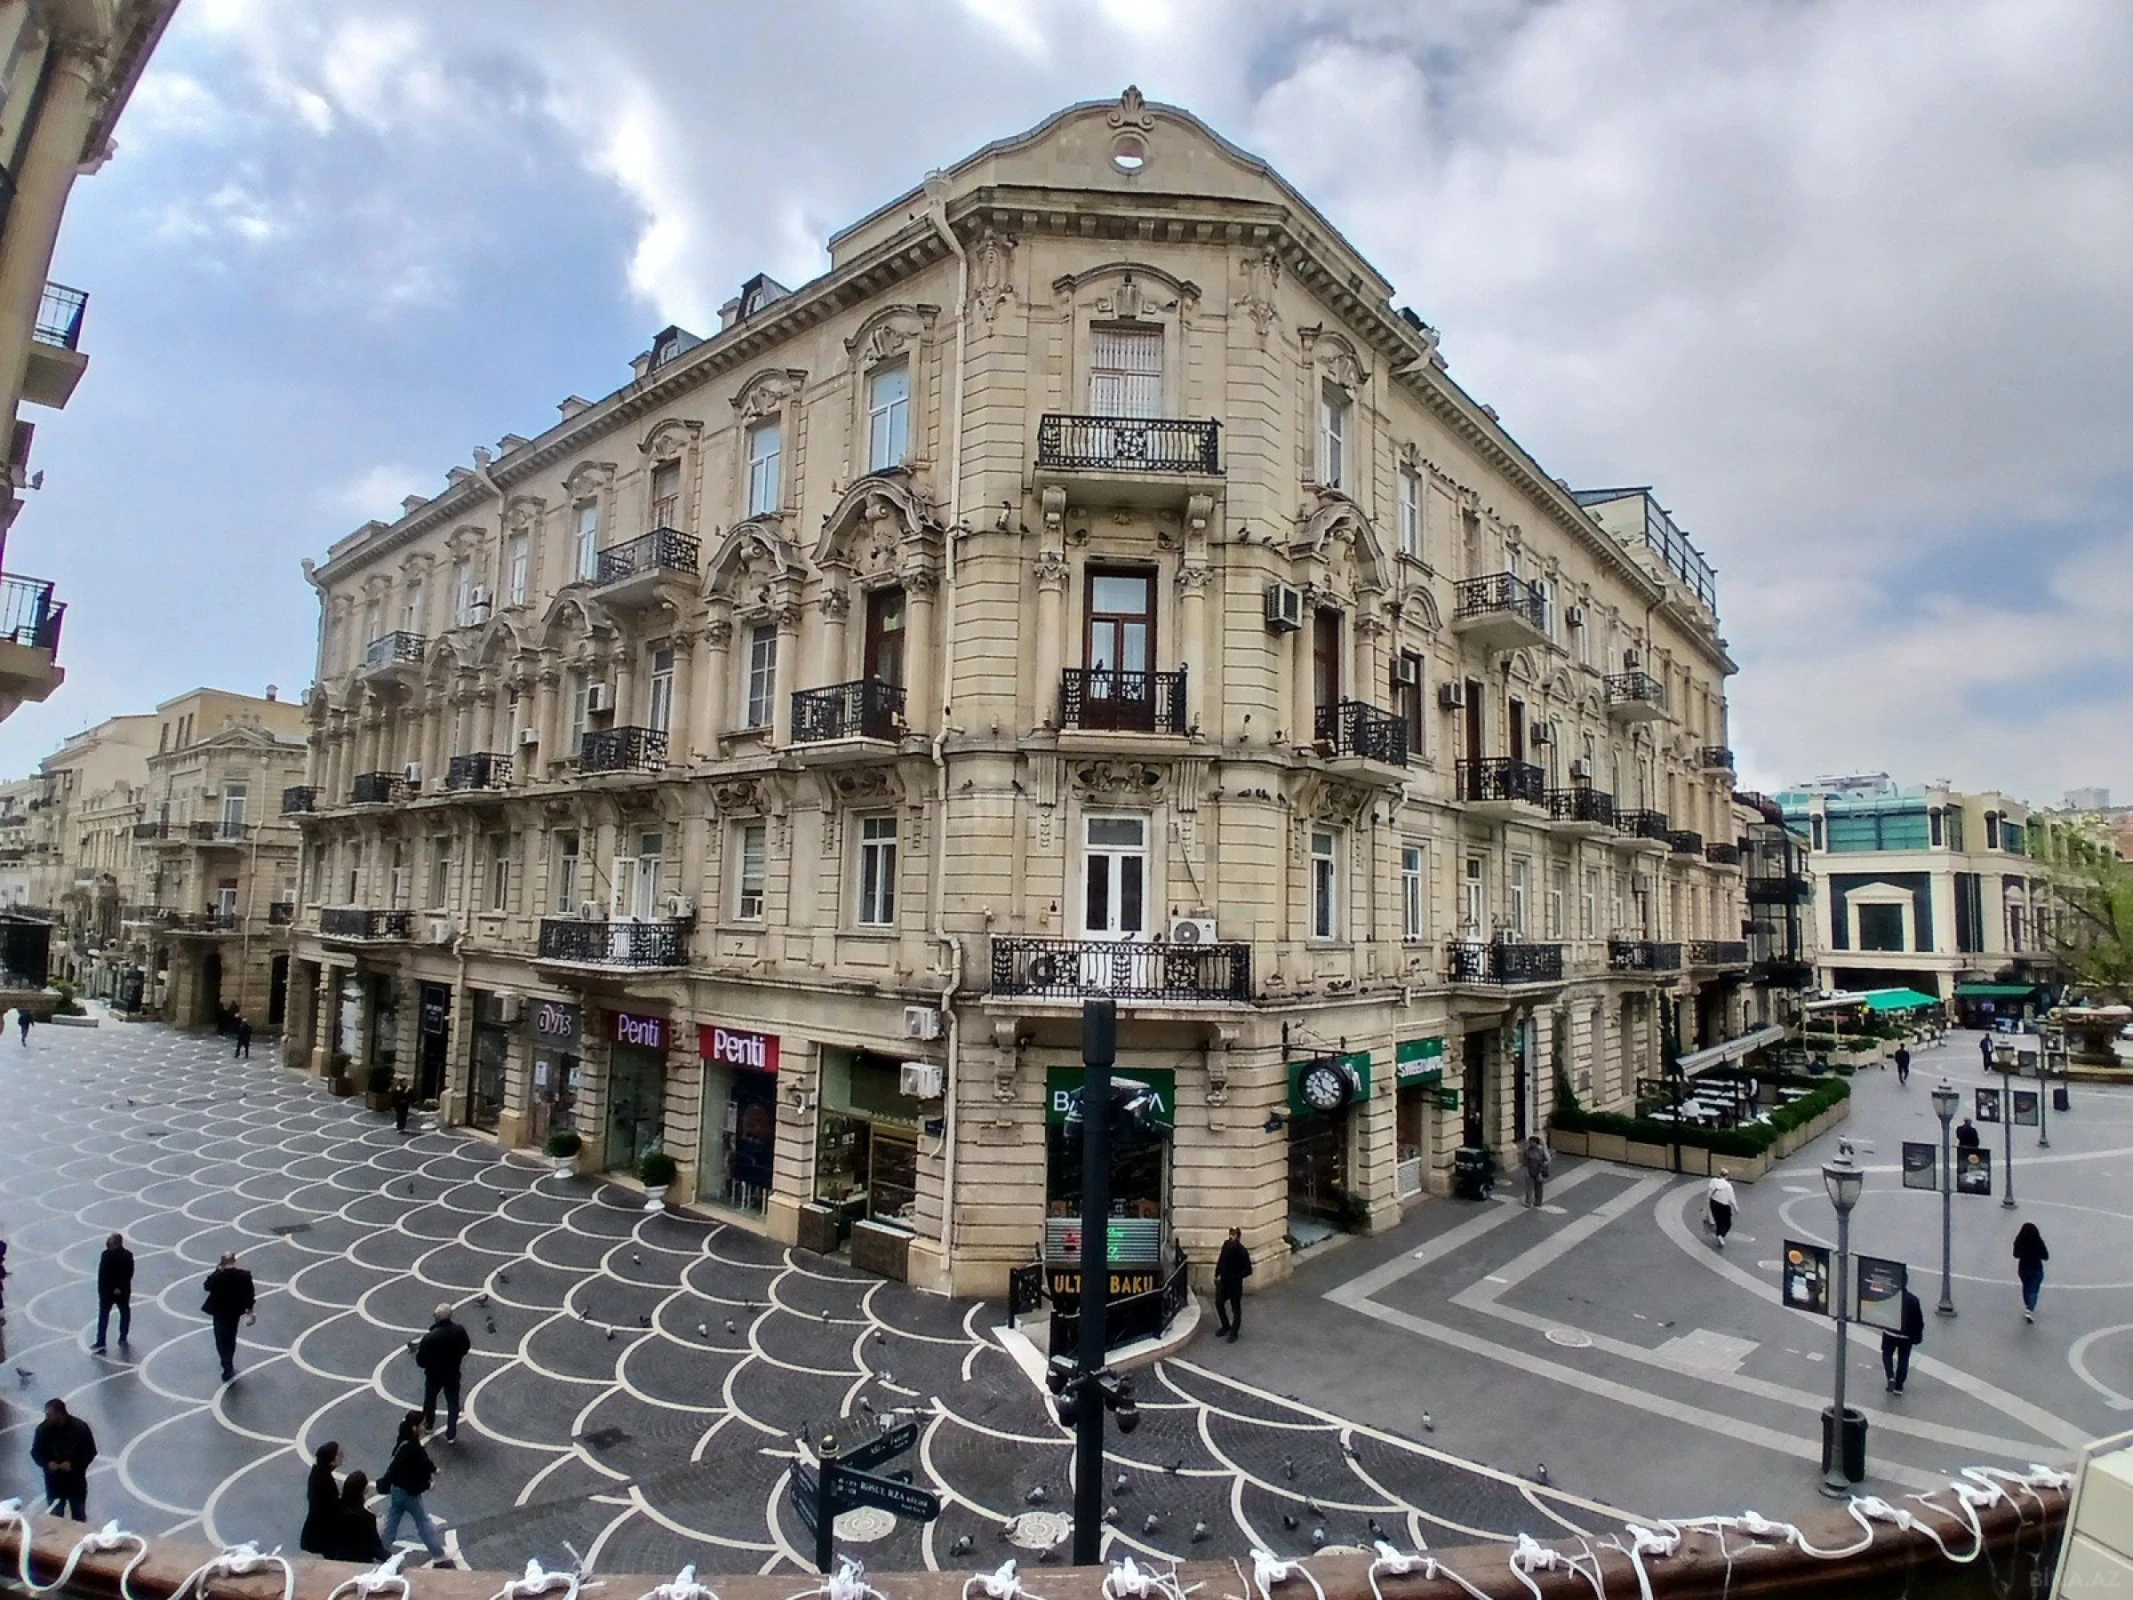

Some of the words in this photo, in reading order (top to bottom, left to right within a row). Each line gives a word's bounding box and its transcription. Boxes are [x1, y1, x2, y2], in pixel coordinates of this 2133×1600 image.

[617, 1013, 660, 1048] Penti
[714, 1028, 766, 1068] Penti
[1109, 1274, 1154, 1294] BAKU
